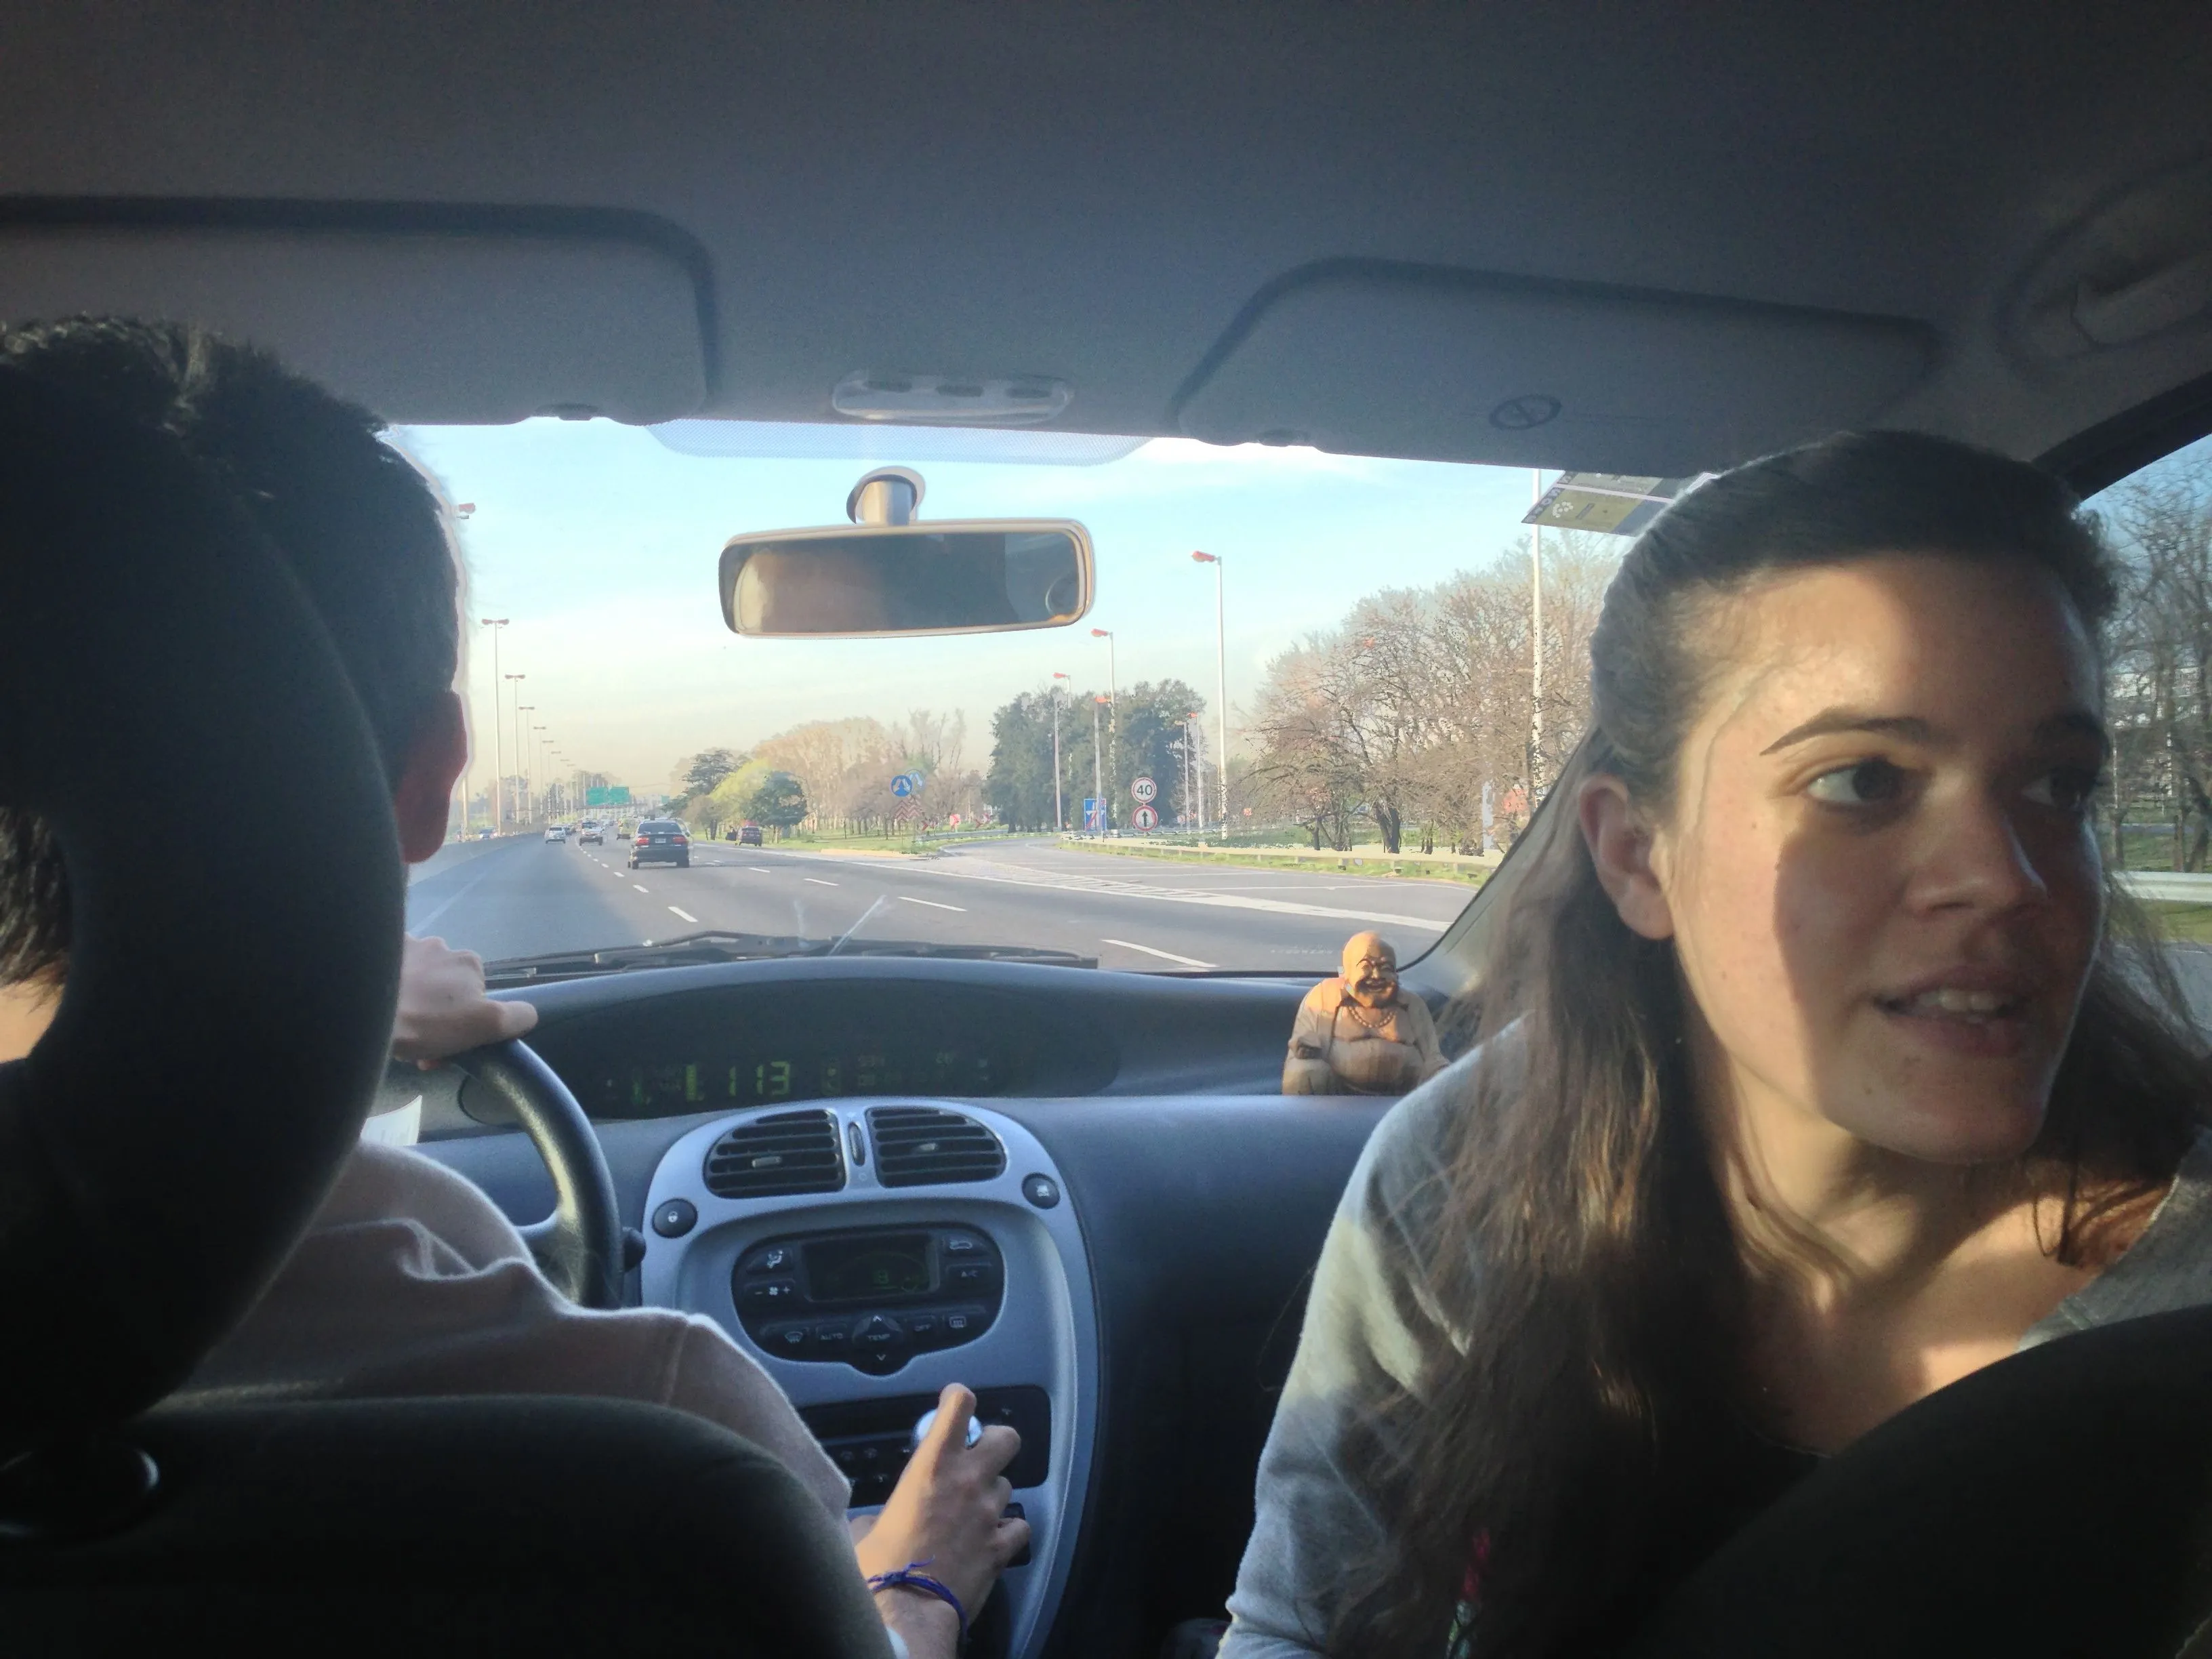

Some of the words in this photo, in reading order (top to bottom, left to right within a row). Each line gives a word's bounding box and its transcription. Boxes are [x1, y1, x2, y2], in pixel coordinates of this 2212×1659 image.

[1136, 785, 1153, 796] 40
[729, 1061, 790, 1097] 113
[820, 1332, 844, 1340] AUTO
